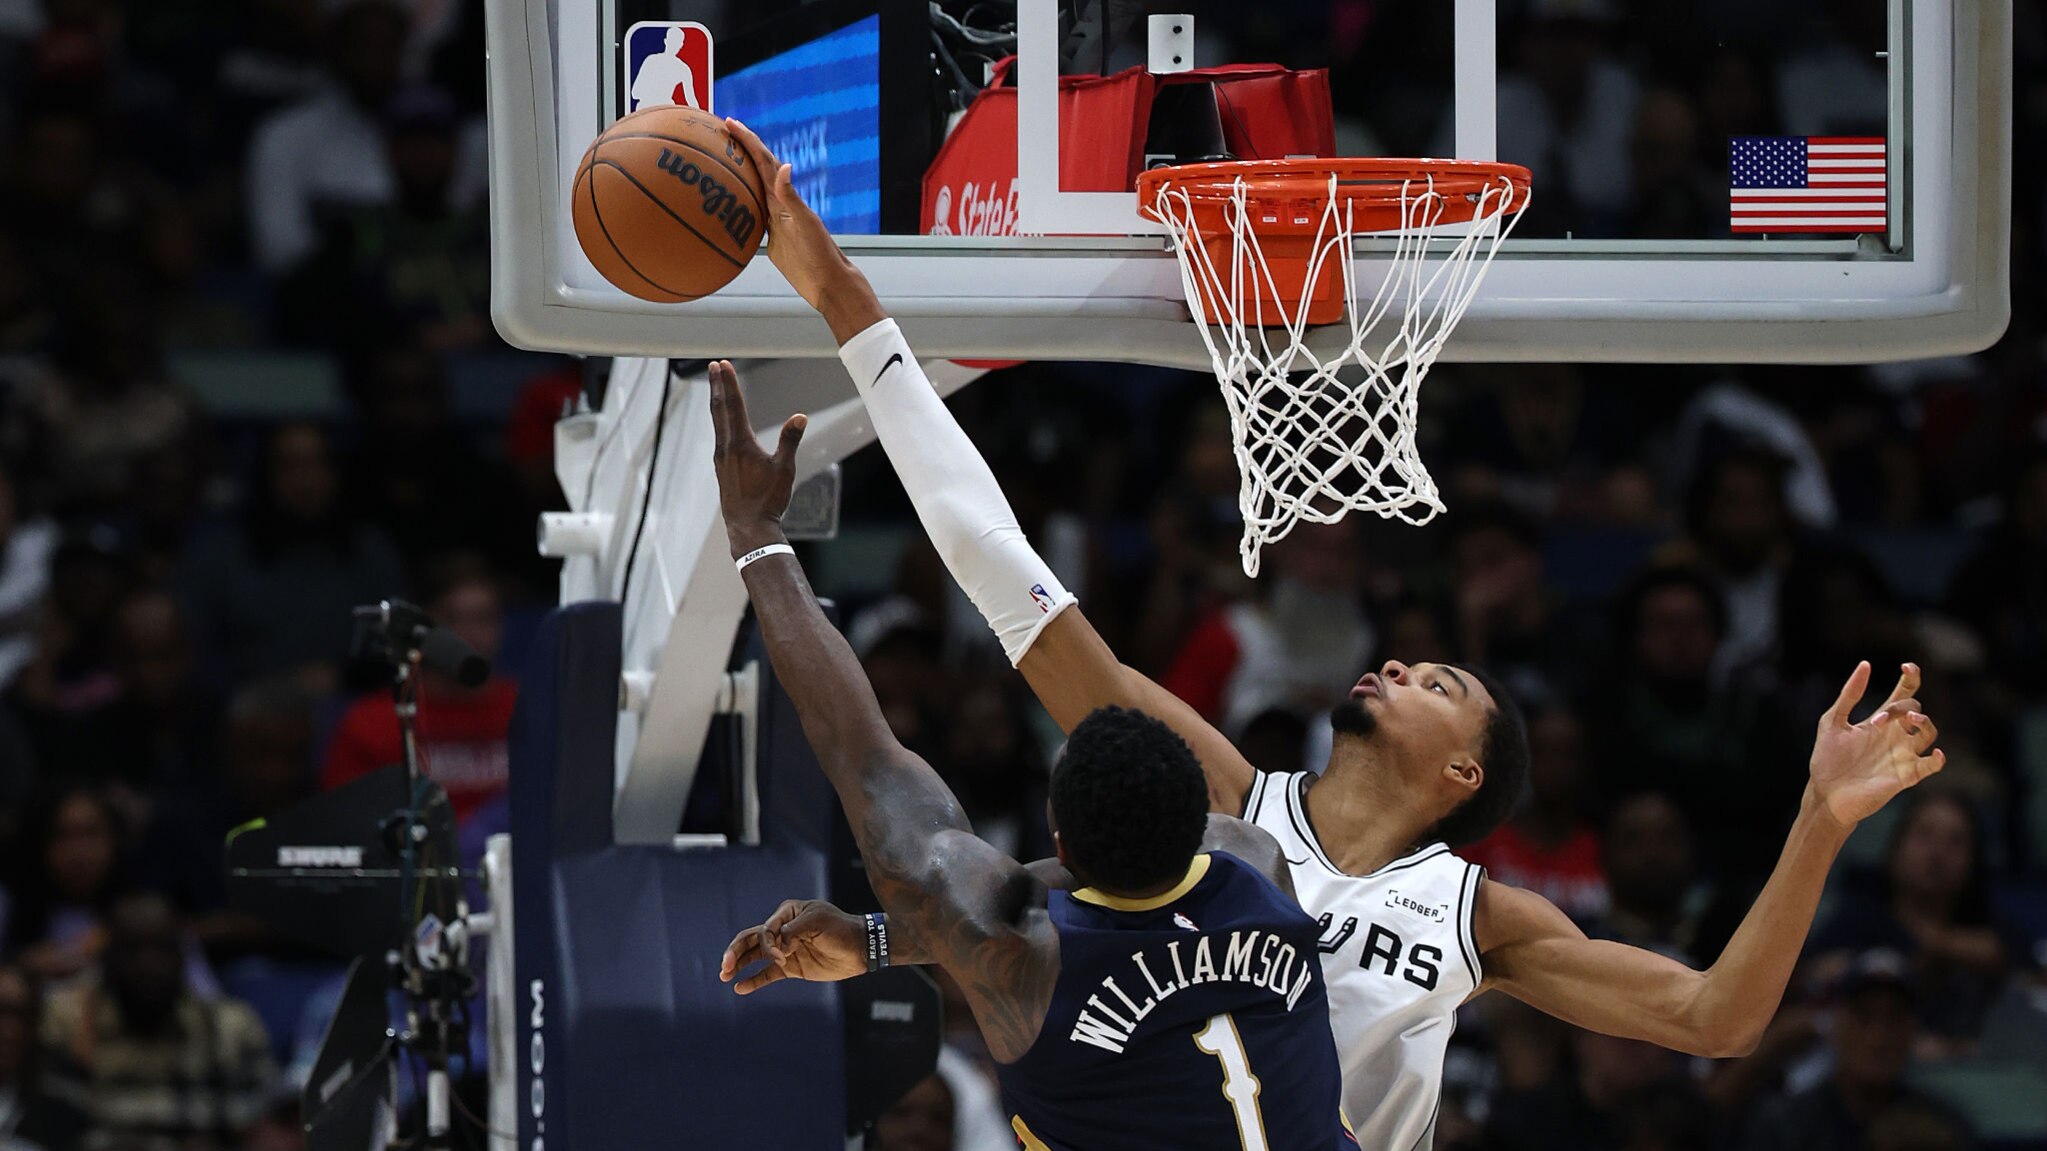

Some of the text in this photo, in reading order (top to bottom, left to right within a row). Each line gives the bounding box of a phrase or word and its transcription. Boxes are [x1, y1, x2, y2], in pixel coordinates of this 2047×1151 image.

[656, 147, 756, 251] Wilson
[744, 549, 766, 563] AZIRA
[1393, 894, 1440, 918] LEDGER
[867, 920, 876, 931] TO
[877, 924, 888, 956] D'EVILS
[869, 934, 877, 959] READY
[1317, 912, 1443, 992] URS
[1069, 930, 1312, 1054] WILLIAMSON
[1192, 1011, 1270, 1151] 1
